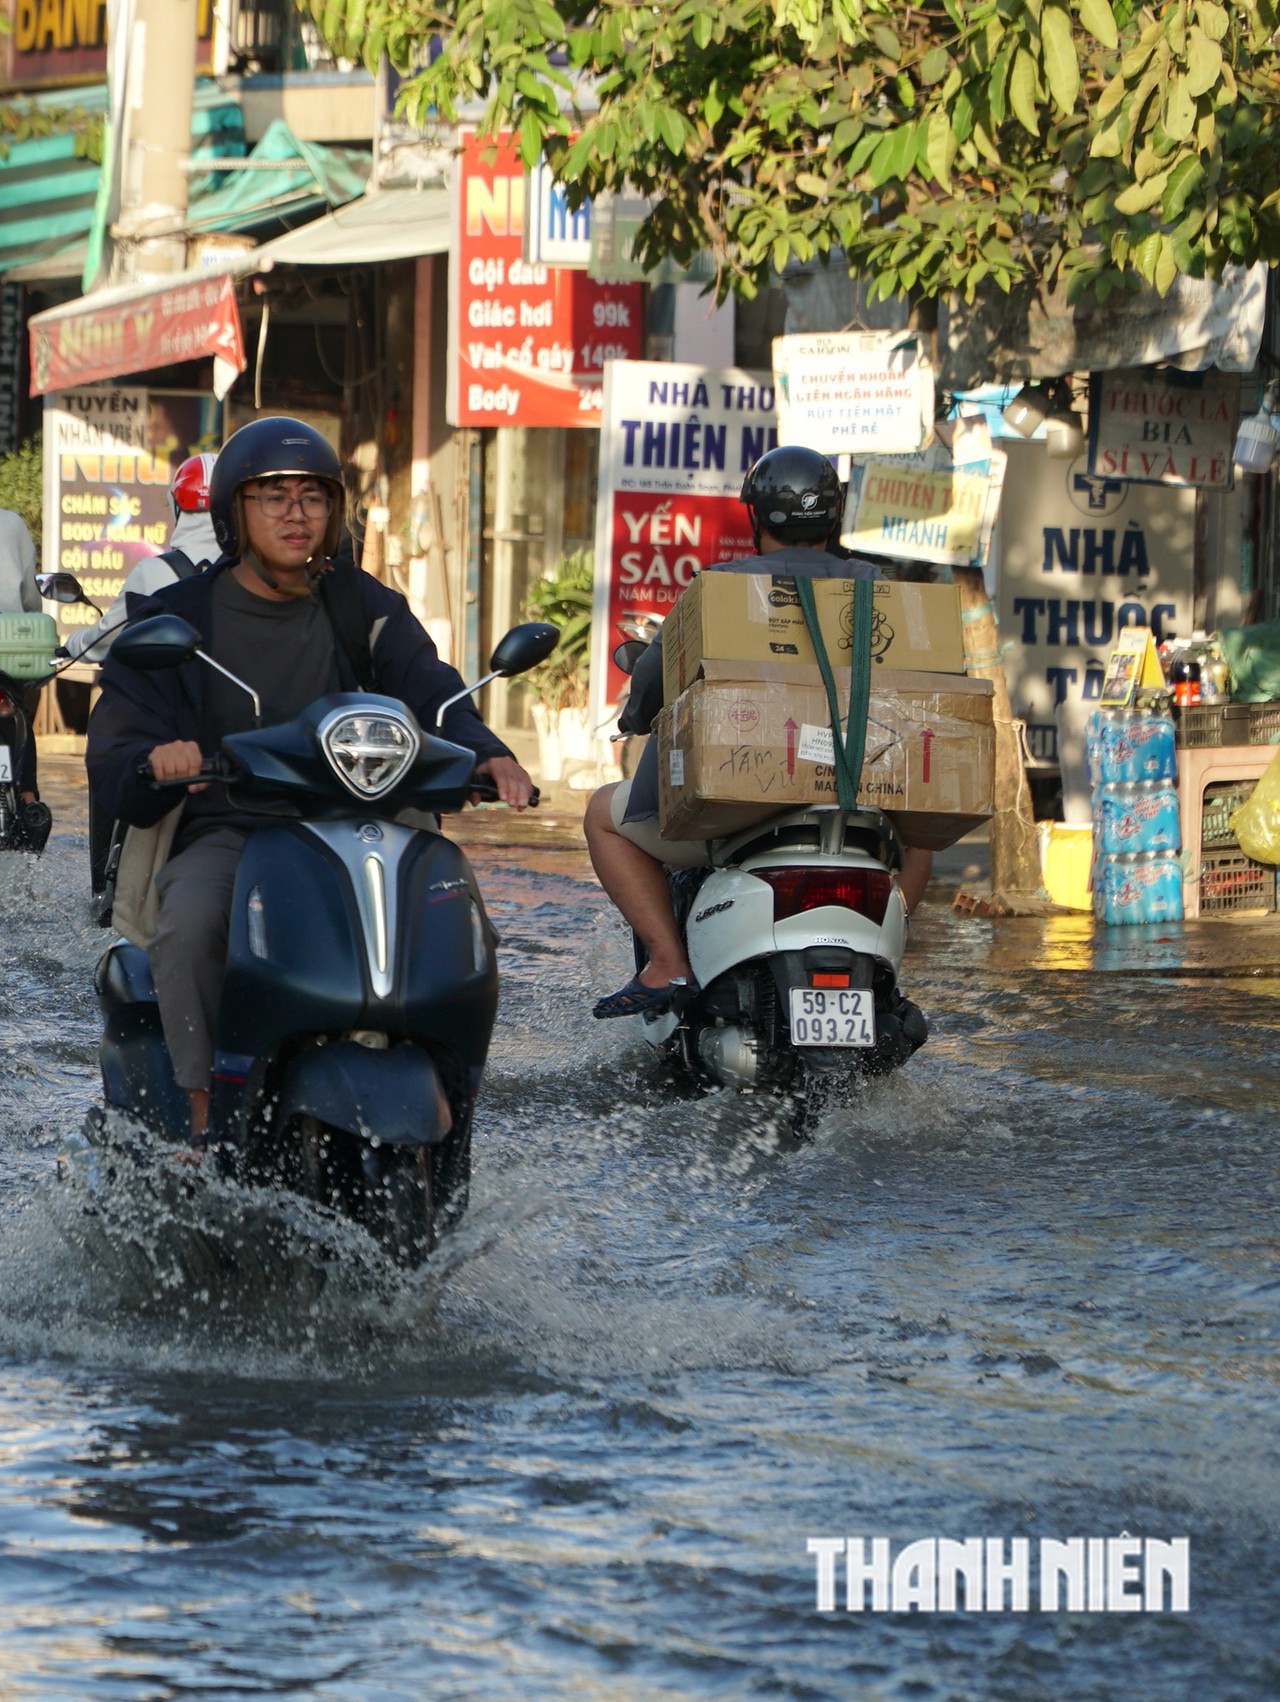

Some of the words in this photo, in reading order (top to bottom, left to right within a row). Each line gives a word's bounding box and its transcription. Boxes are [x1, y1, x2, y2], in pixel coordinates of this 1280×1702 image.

[468, 257, 504, 292] Gội
[468, 299, 516, 327] Giác
[520, 299, 553, 327] hơi
[593, 302, 630, 328] 99k
[537, 340, 574, 372] gáy
[581, 344, 629, 367] 149k
[62, 390, 138, 413] TUYỂN
[468, 384, 519, 416] Body
[649, 378, 709, 408] NHÀ
[721, 384, 776, 411] THU
[1107, 388, 1192, 419] THUỐC
[621, 415, 726, 481] THIỆN
[1141, 420, 1193, 446] BIA
[1140, 448, 1179, 477] VÀ
[61, 522, 103, 542] BODY
[144, 521, 167, 545] NỮ
[622, 499, 701, 547] YẾN
[882, 515, 948, 550] NHANH
[1043, 520, 1150, 576] NHÀ
[620, 546, 702, 586] SÀO
[619, 587, 653, 601] NAM
[61, 602, 97, 625] GIÁC
[1014, 585, 1176, 647] THUỐC
[1046, 659, 1106, 707] TÂ
[866, 782, 904, 796] CHINA
[802, 991, 862, 1016] 59-C2
[796, 1018, 871, 1043] 093.24
